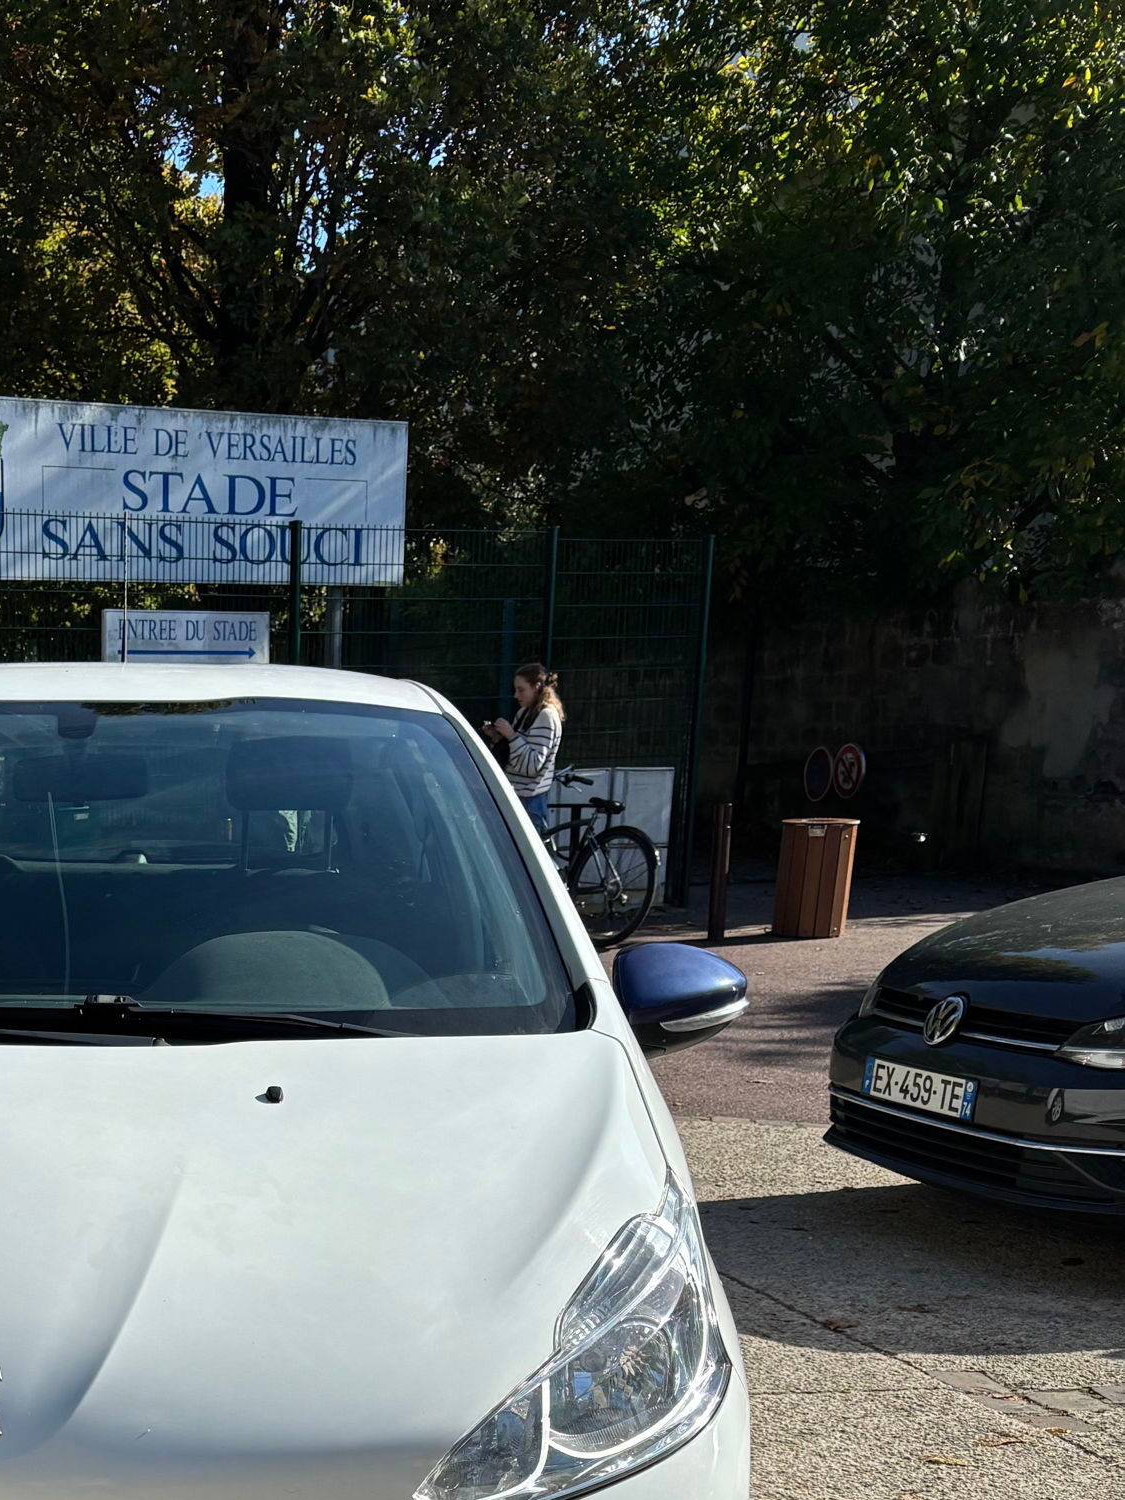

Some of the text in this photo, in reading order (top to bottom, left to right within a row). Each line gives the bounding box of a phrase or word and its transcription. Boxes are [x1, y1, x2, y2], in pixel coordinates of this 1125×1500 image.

[56, 423, 357, 466] VILLE DE VERSAILLES
[122, 470, 298, 517] STADE
[42, 517, 365, 566] SANS SOUCI
[185, 620, 206, 641] DU
[213, 620, 257, 642] STADE
[961, 1101, 972, 1117] 74
